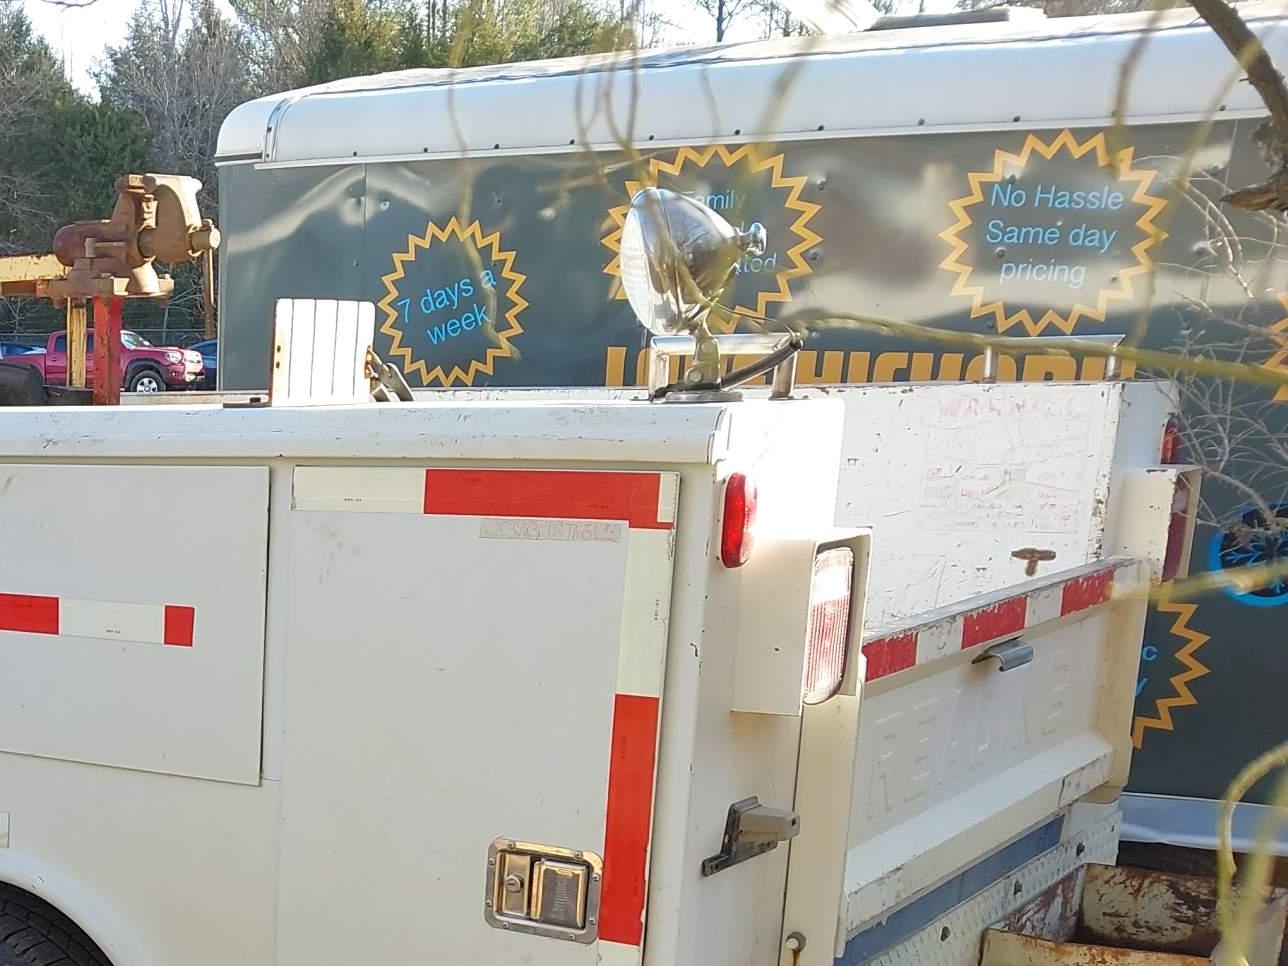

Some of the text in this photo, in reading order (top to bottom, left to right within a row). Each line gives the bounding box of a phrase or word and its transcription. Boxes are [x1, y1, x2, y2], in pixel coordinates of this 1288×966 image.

[990, 183, 1125, 210] No Hassle
[985, 219, 1118, 254] Same day
[999, 257, 1087, 289] pricing
[396, 269, 497, 323] 7 days a
[426, 303, 492, 345] week
